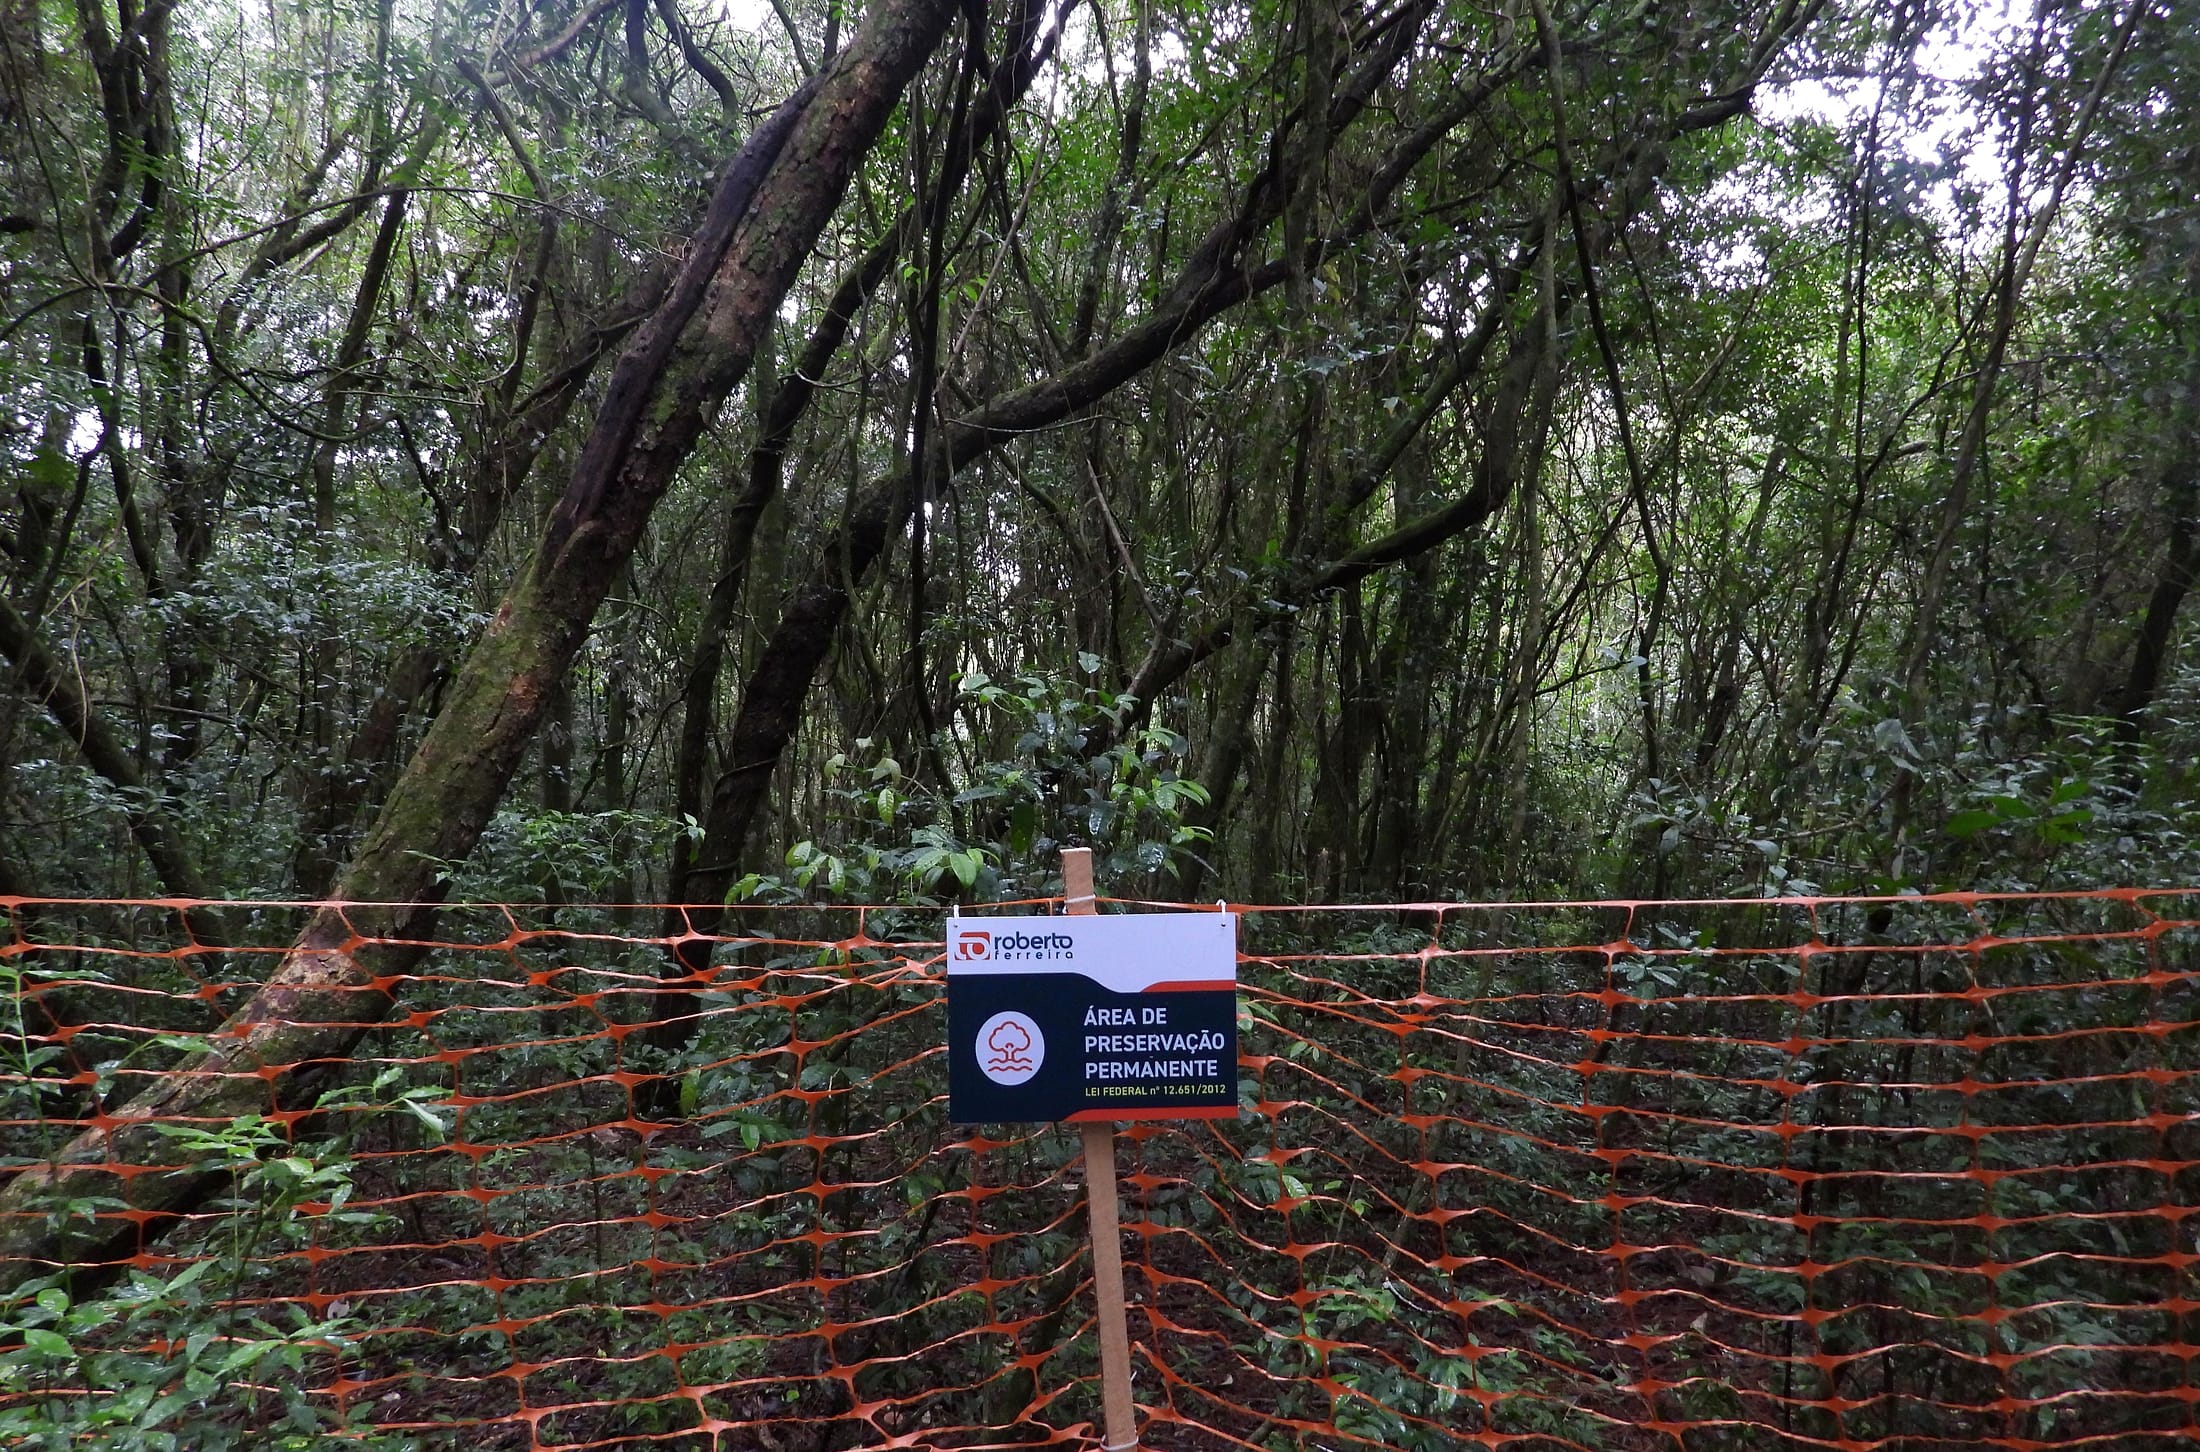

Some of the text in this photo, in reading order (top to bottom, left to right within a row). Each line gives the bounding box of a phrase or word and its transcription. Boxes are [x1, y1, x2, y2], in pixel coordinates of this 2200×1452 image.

[994, 931, 1073, 950] roberto
[994, 950, 1073, 960] ferreira
[1084, 1005, 1167, 1026] ÁREA DE
[1085, 1030, 1225, 1054] PRESERVAÇÃO
[1085, 1060, 1218, 1079] PERMANENTE
[1085, 1087, 1100, 1097] LEI
[1103, 1086, 1147, 1096] FEDERAL
[1163, 1083, 1226, 1095] 12.651/2012
